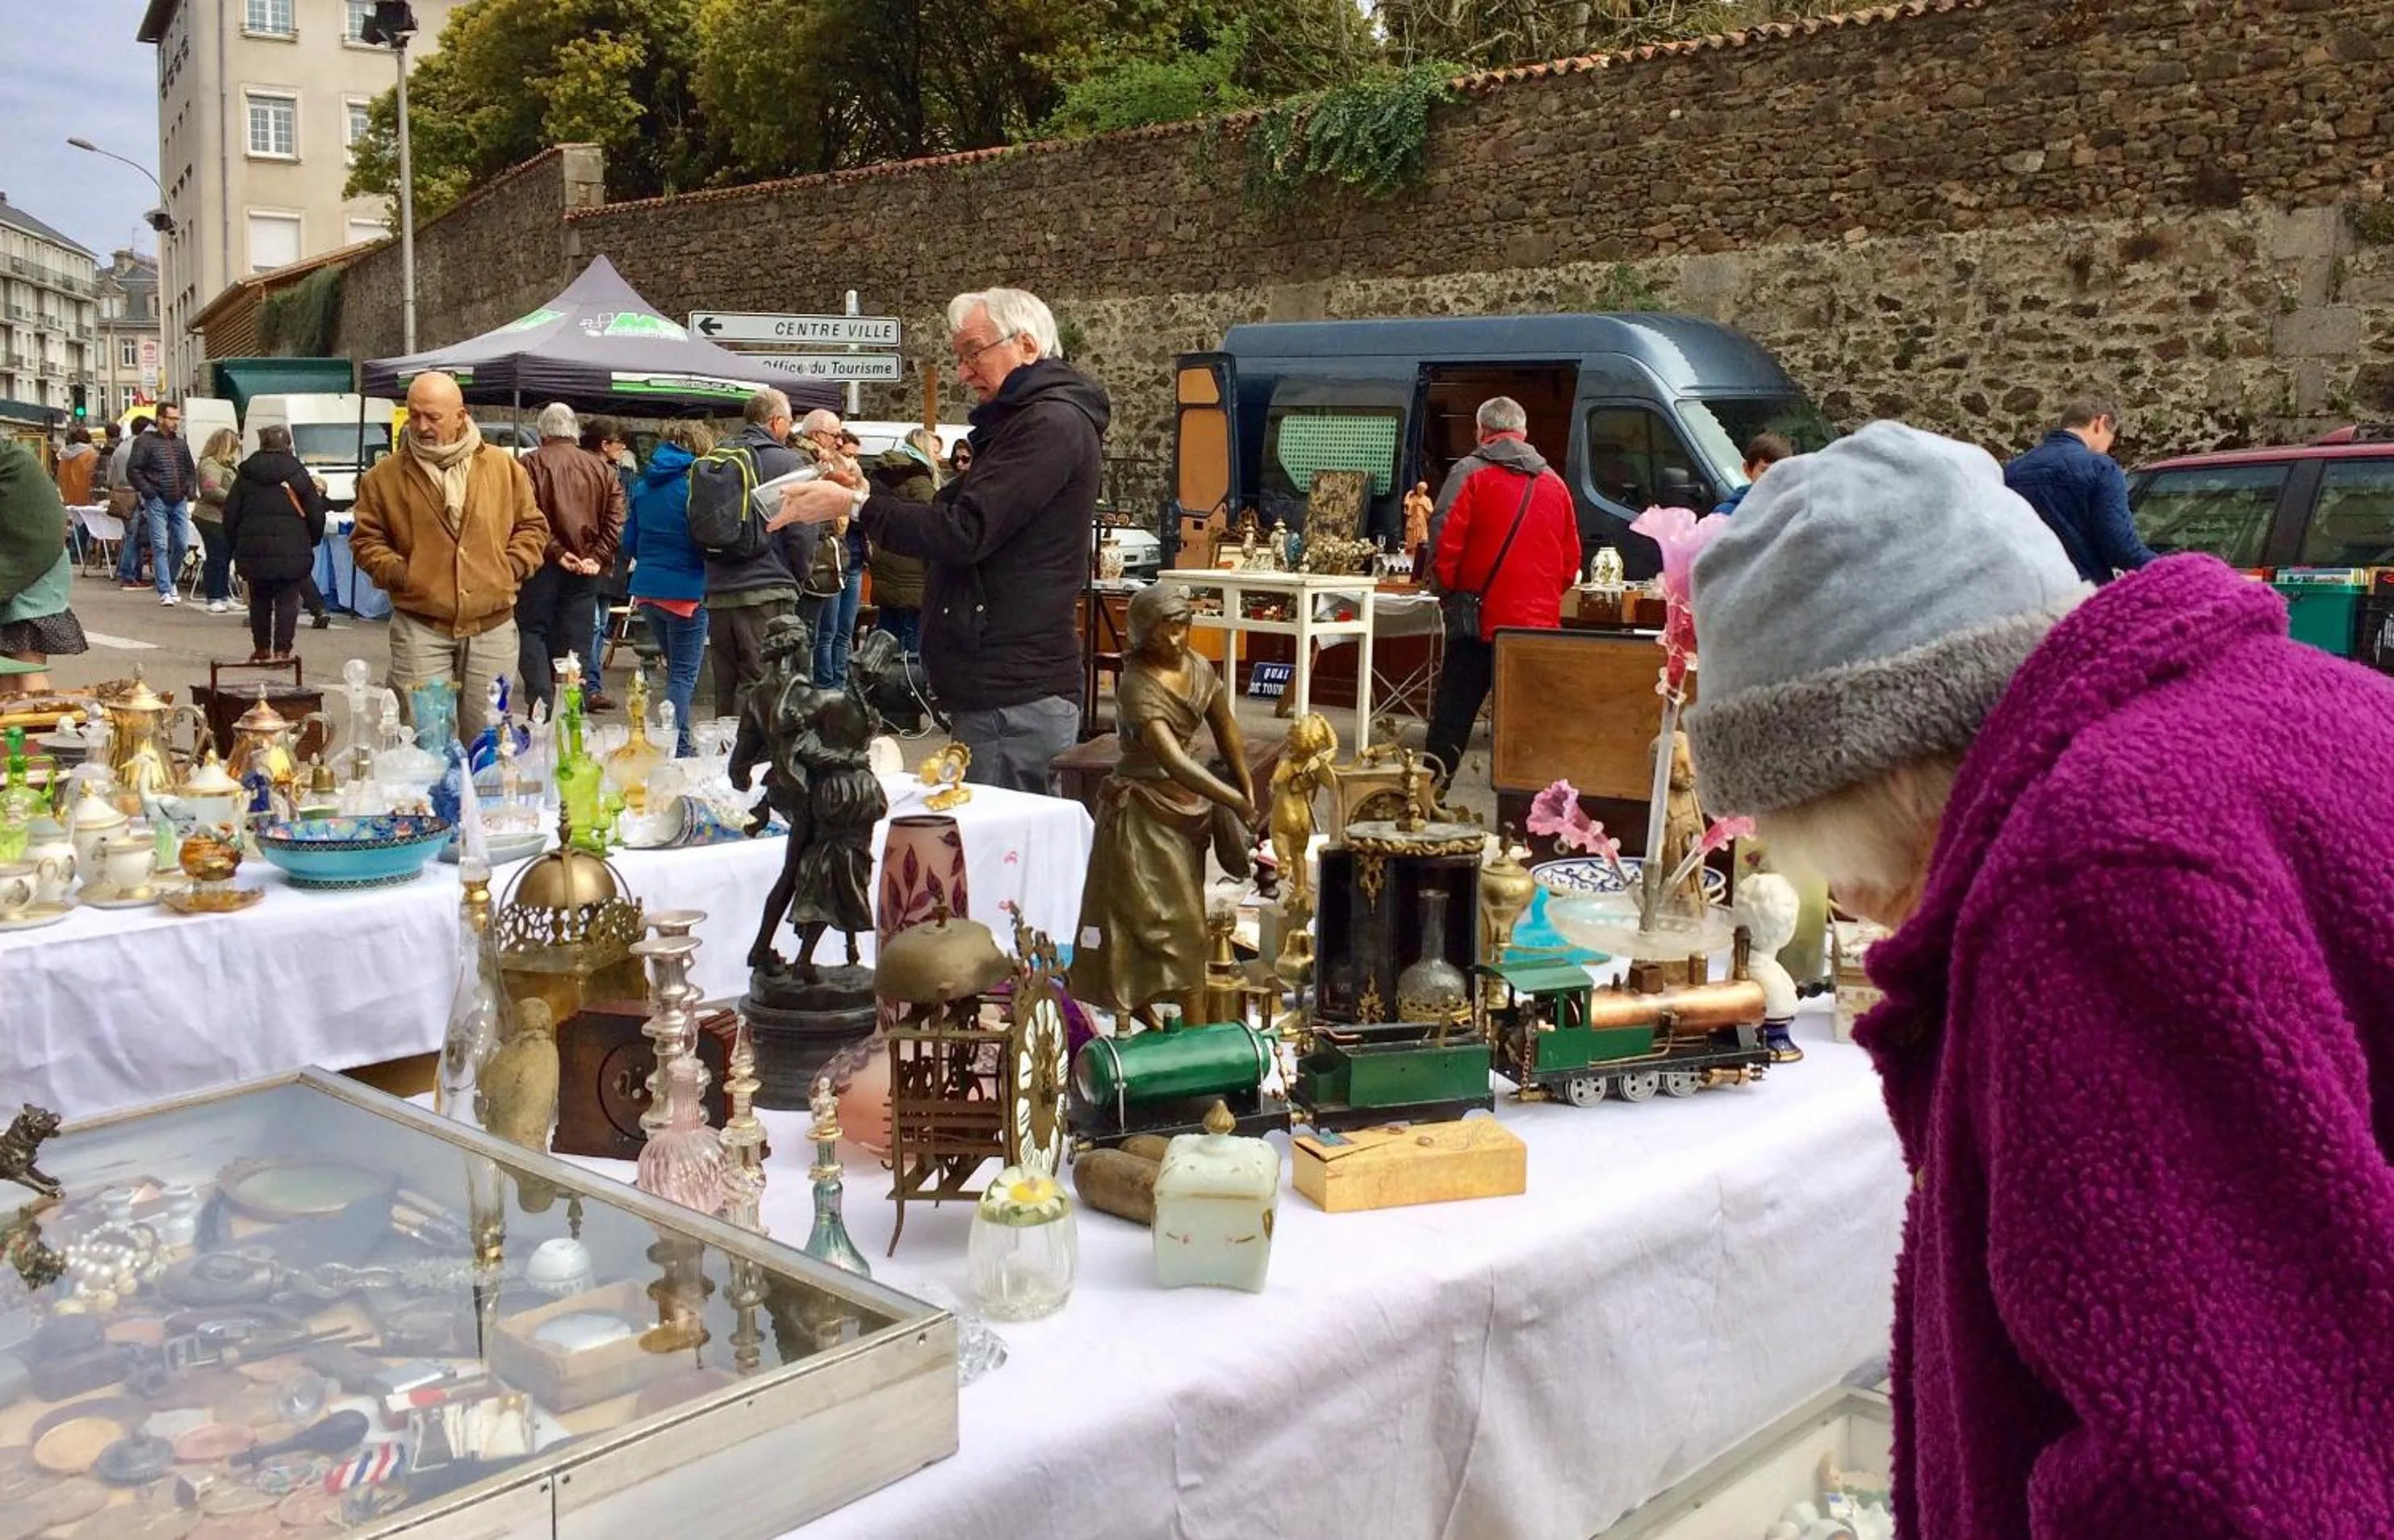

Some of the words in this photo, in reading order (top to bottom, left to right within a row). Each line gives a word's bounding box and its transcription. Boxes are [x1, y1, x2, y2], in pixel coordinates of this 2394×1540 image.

[775, 322, 840, 337] CENTRE
[848, 324, 892, 337] VILLE
[810, 362, 826, 375] du
[831, 361, 892, 375] Tourisme
